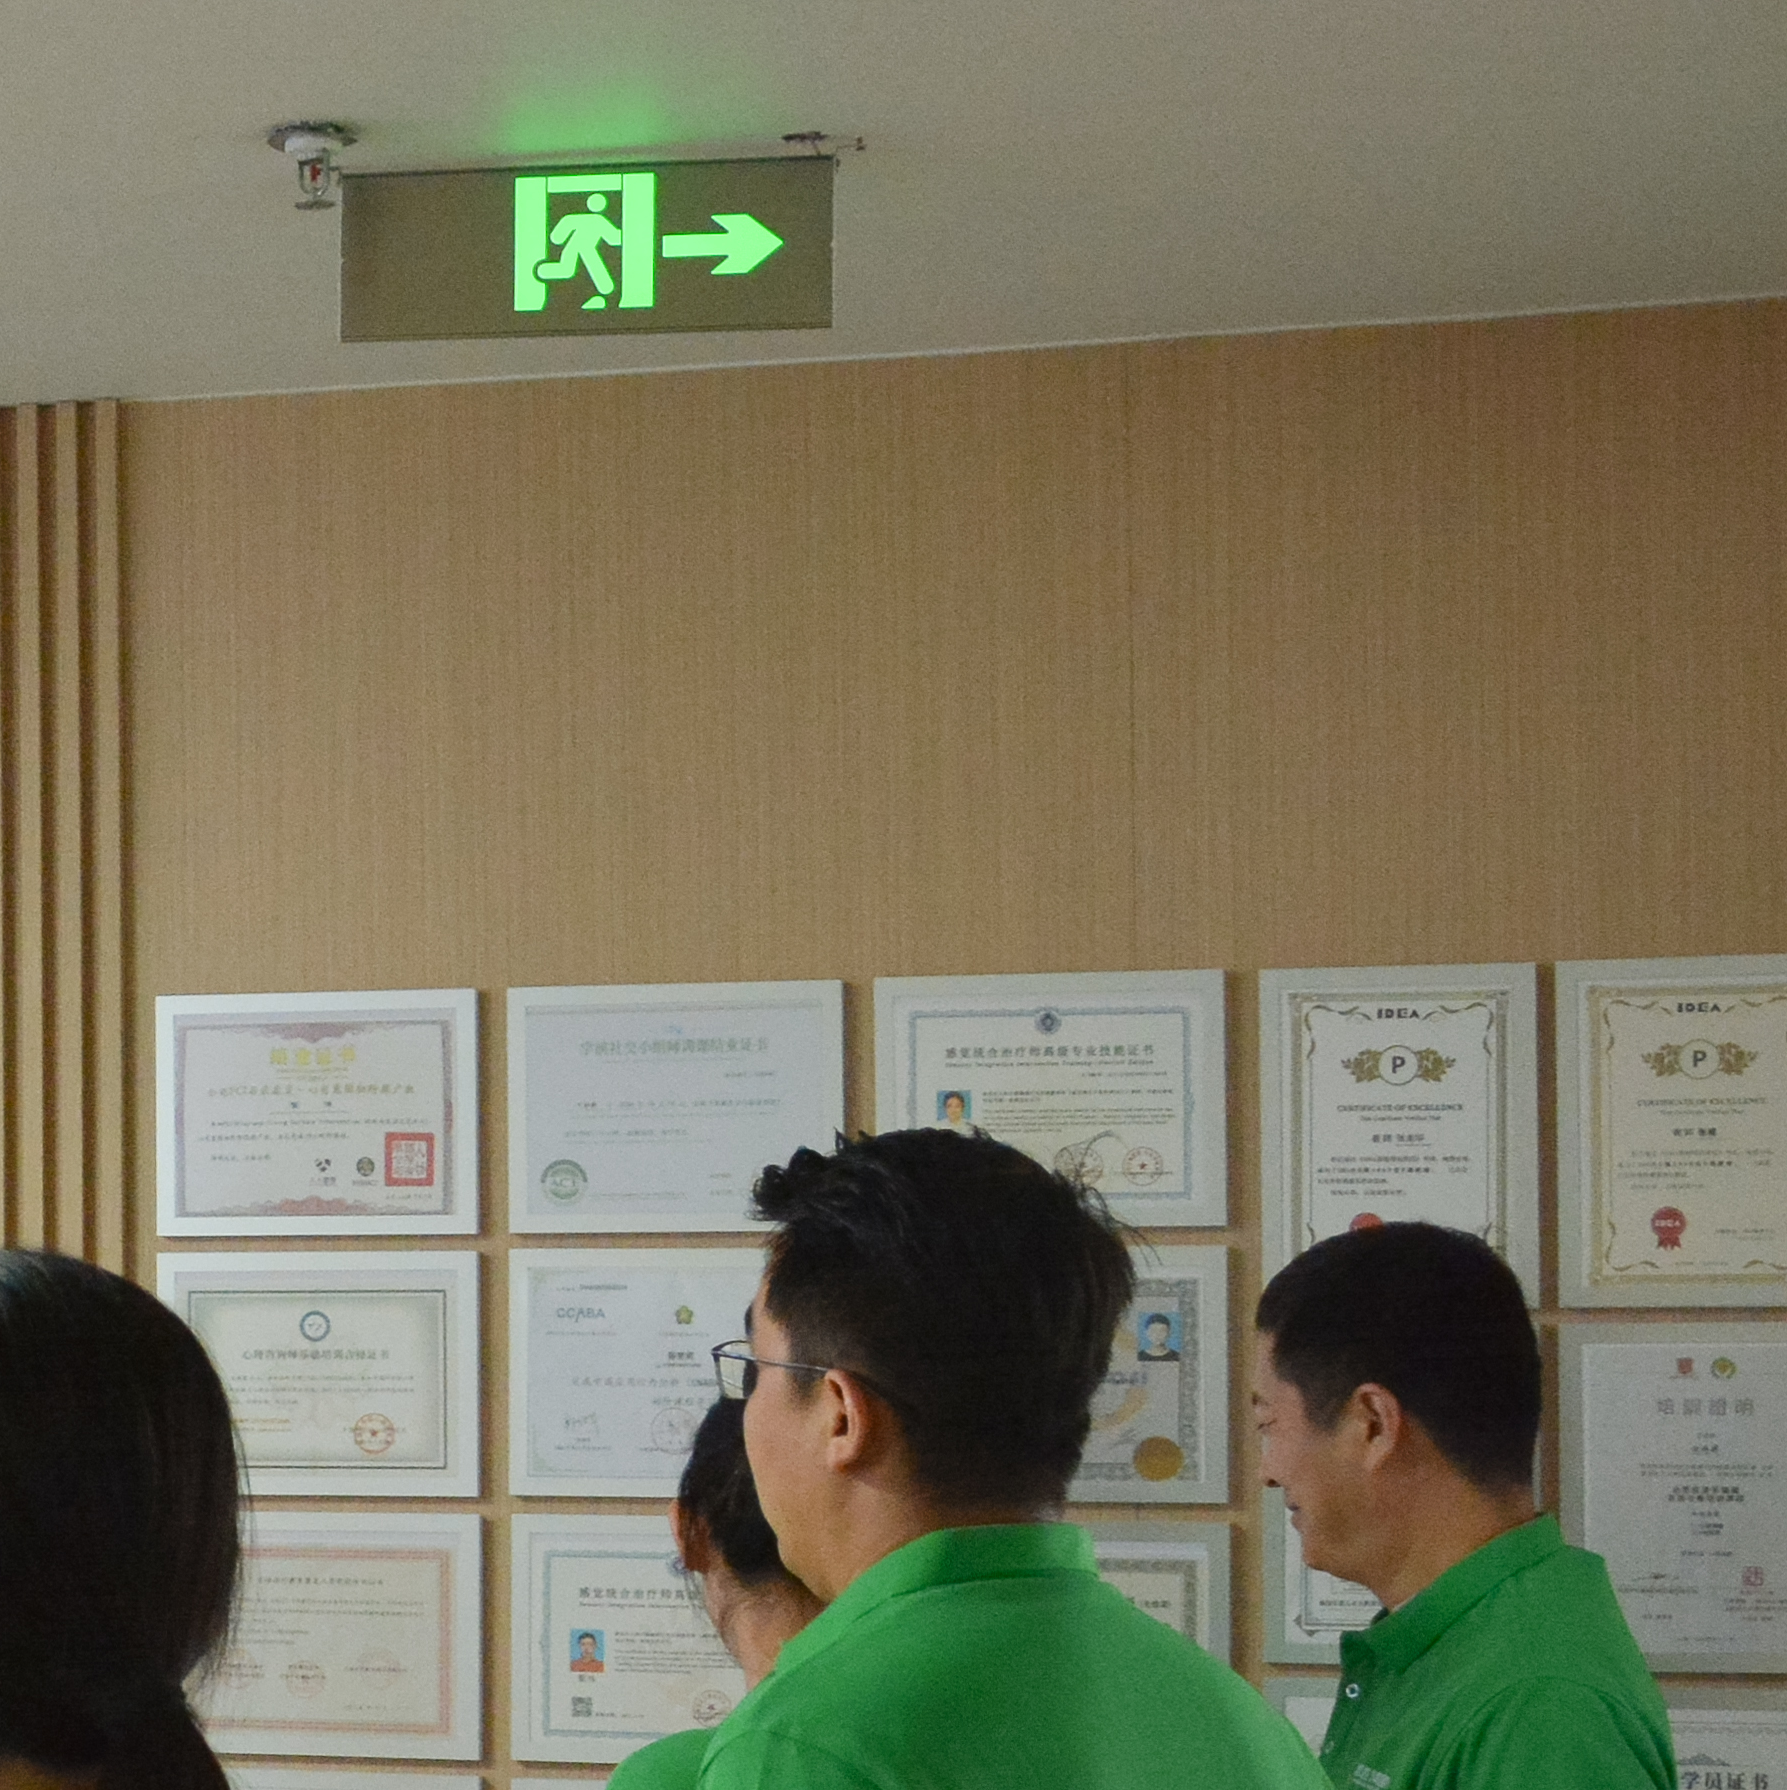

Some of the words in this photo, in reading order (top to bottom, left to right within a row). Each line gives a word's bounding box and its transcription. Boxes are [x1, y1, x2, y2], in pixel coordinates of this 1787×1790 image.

[1376, 1007, 1420, 1019] IDEA
[1676, 1002, 1722, 1013] IDEA
[1391, 1055, 1406, 1074] P
[1692, 1050, 1708, 1067] P
